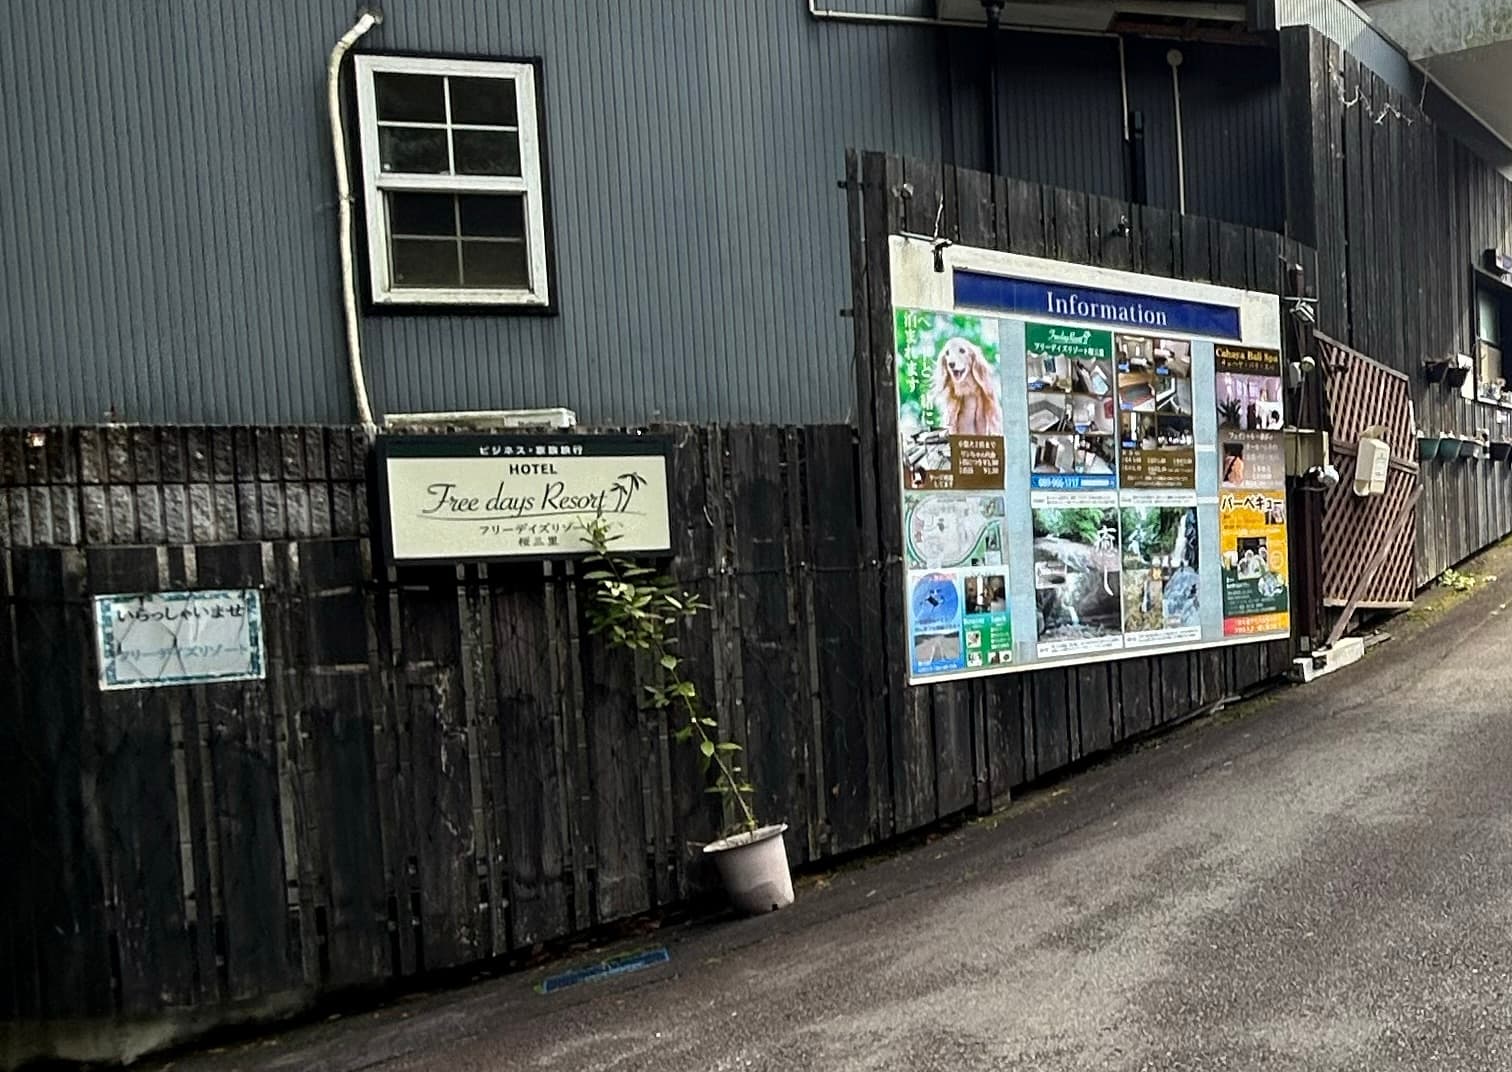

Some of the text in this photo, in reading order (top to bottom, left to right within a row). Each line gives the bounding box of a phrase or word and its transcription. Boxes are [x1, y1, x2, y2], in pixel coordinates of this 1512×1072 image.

[1046, 291, 1168, 326] Information
[479, 445, 583, 456] ビジネス・家族旅行
[509, 463, 558, 475] HOTEL
[422, 481, 608, 517] Free days Resort
[479, 522, 597, 535] フリーデイズリゾー
[117, 603, 245, 622] いらっしゃいませ
